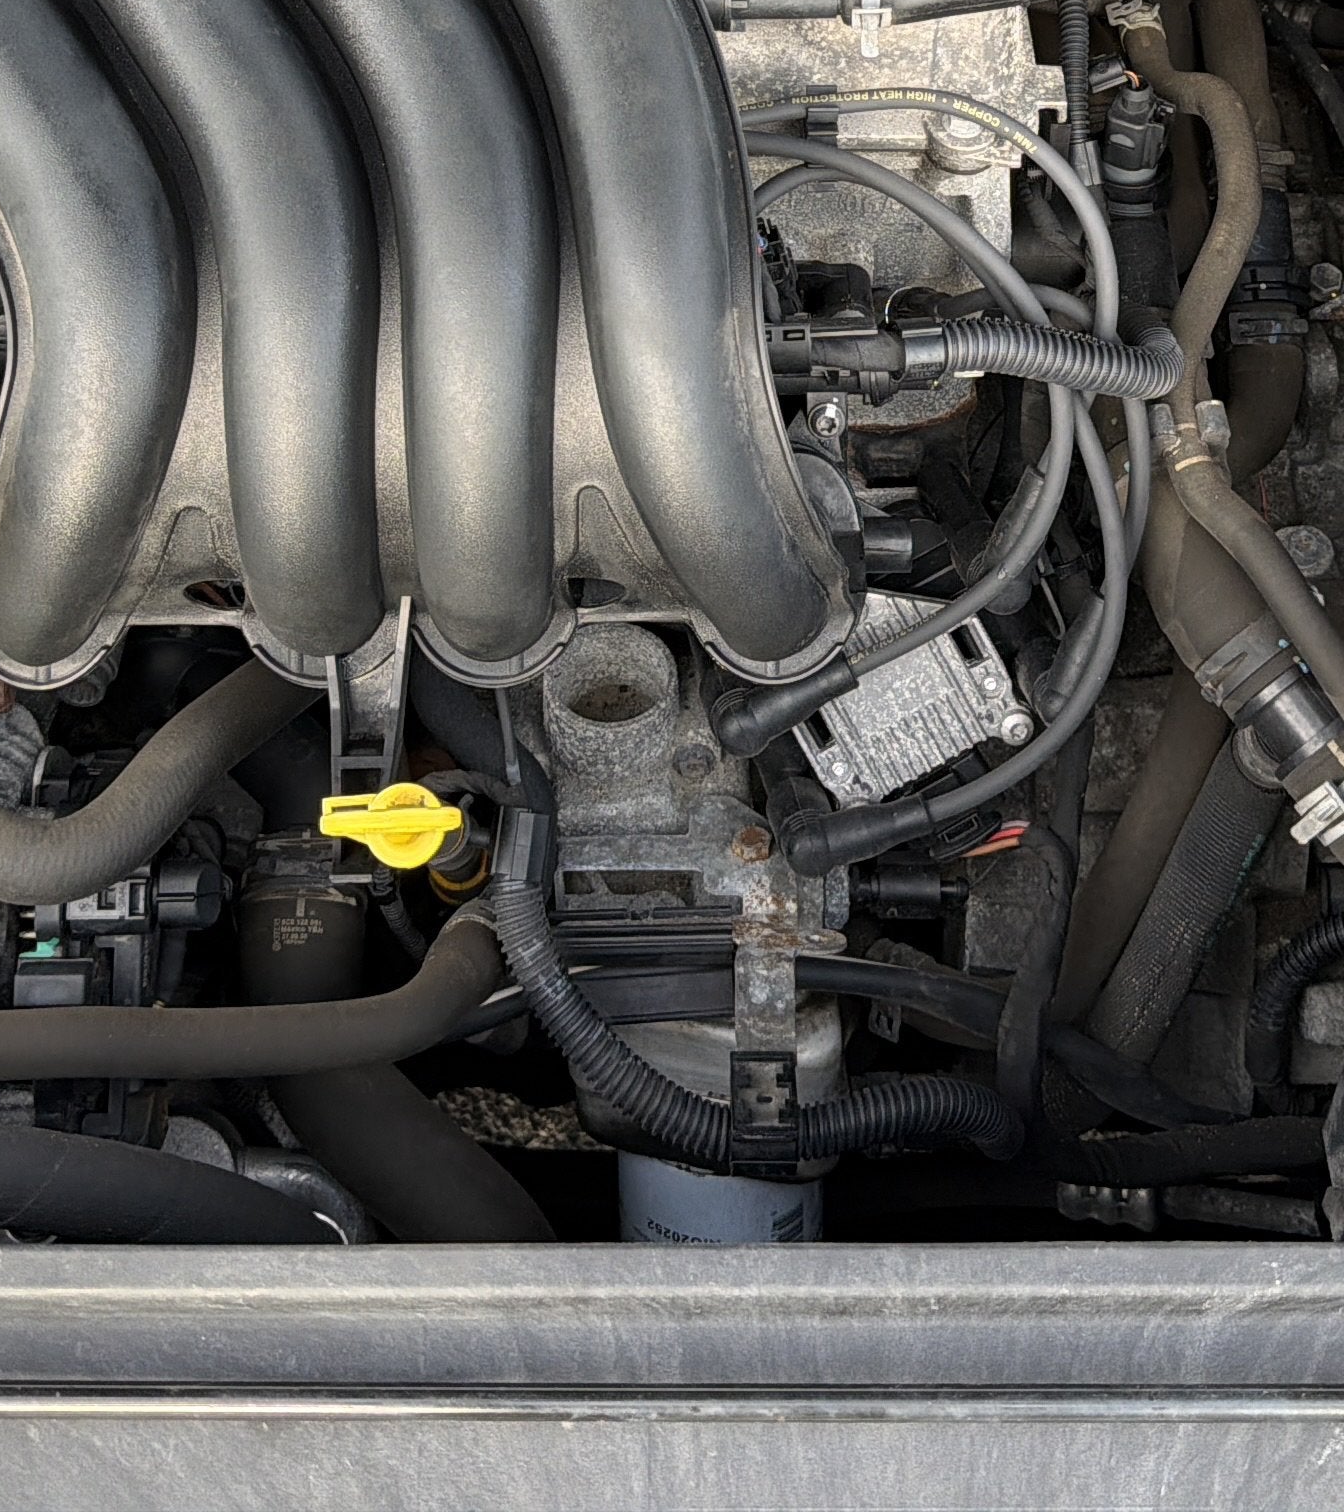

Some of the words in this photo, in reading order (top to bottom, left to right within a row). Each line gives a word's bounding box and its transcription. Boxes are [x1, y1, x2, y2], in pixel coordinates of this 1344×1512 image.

[791, 90, 869, 106] PROTECTION
[871, 89, 906, 101] HEAT
[906, 90, 936, 104] HIGH
[952, 98, 1001, 128] COPPER
[1012, 131, 1039, 155] 7MM
